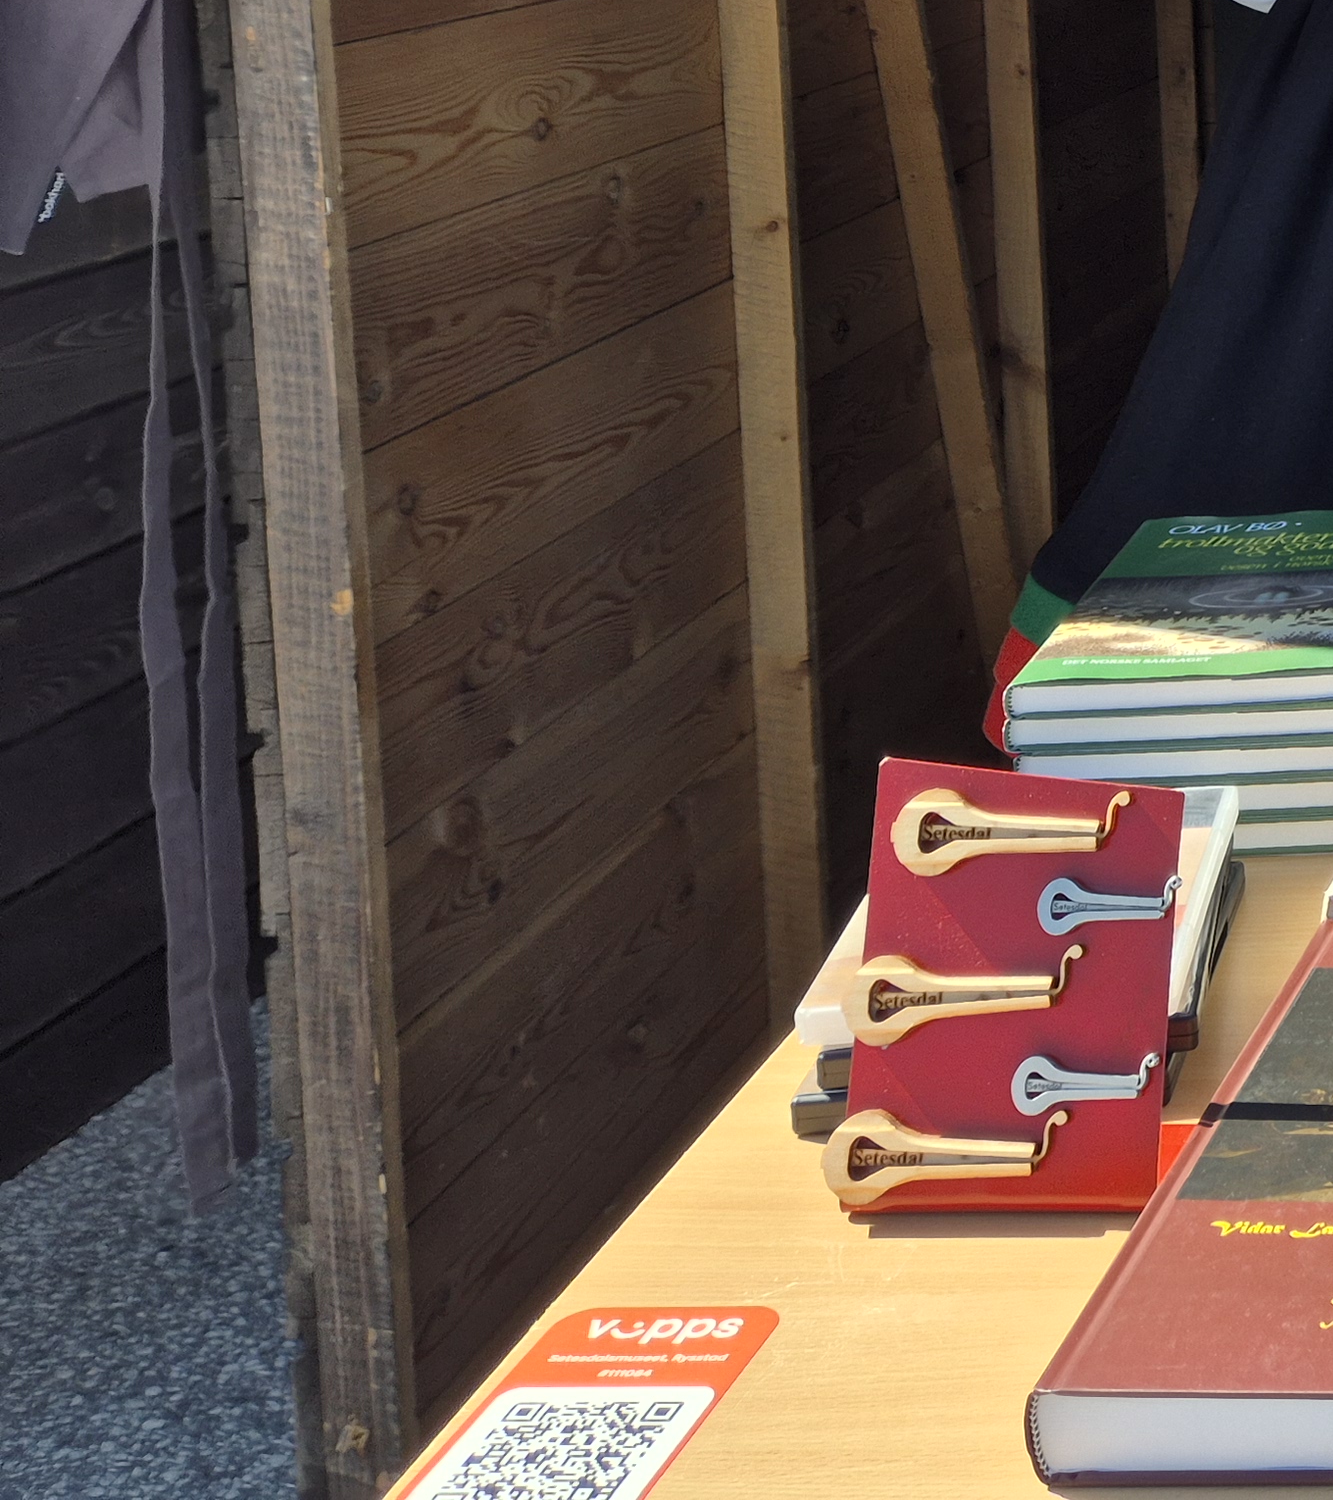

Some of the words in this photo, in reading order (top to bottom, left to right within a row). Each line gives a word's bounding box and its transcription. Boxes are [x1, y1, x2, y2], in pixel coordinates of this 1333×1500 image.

[1168, 523, 1244, 535] OLAV
[920, 825, 992, 842] Setesdal
[873, 991, 944, 1011] Setesdal
[853, 1149, 924, 1167] Setesdal
[1211, 1220, 1286, 1237] Vidar
